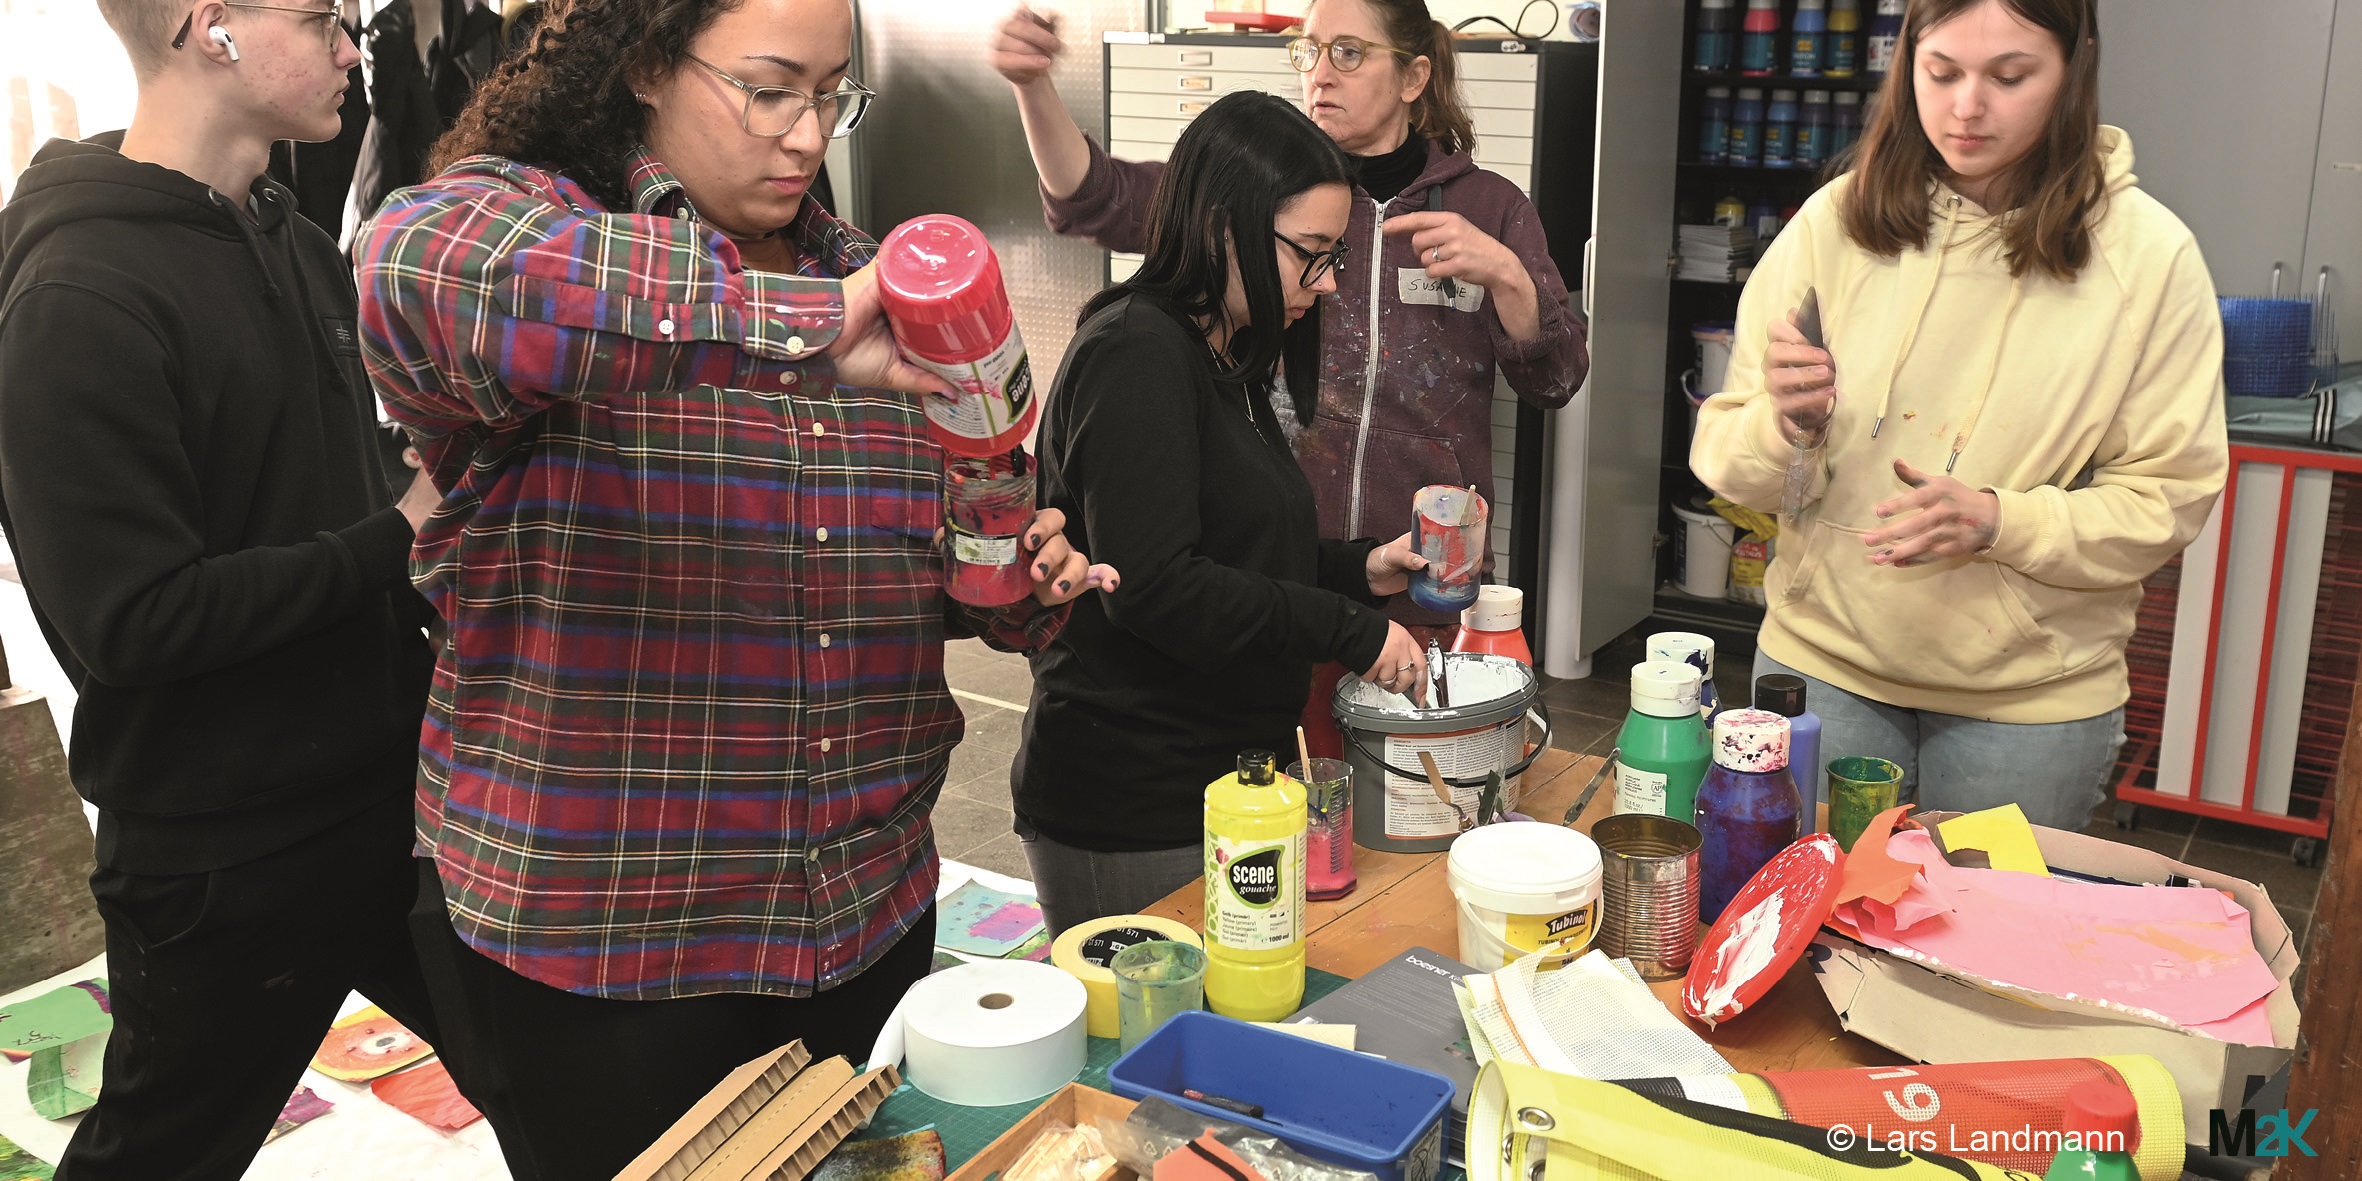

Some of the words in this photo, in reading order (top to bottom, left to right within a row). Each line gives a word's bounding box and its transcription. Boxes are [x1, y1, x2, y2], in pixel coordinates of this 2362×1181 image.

[1407, 278, 1467, 298] SUSAE
[1233, 865, 1274, 884] scene
[1239, 884, 1276, 894] gouache
[1550, 910, 1587, 933] Tubinol
[1126, 928, 1139, 938] 571
[1269, 935, 1282, 943] 1000
[1094, 939, 1105, 947] 571
[1405, 955, 1451, 976] boesner
